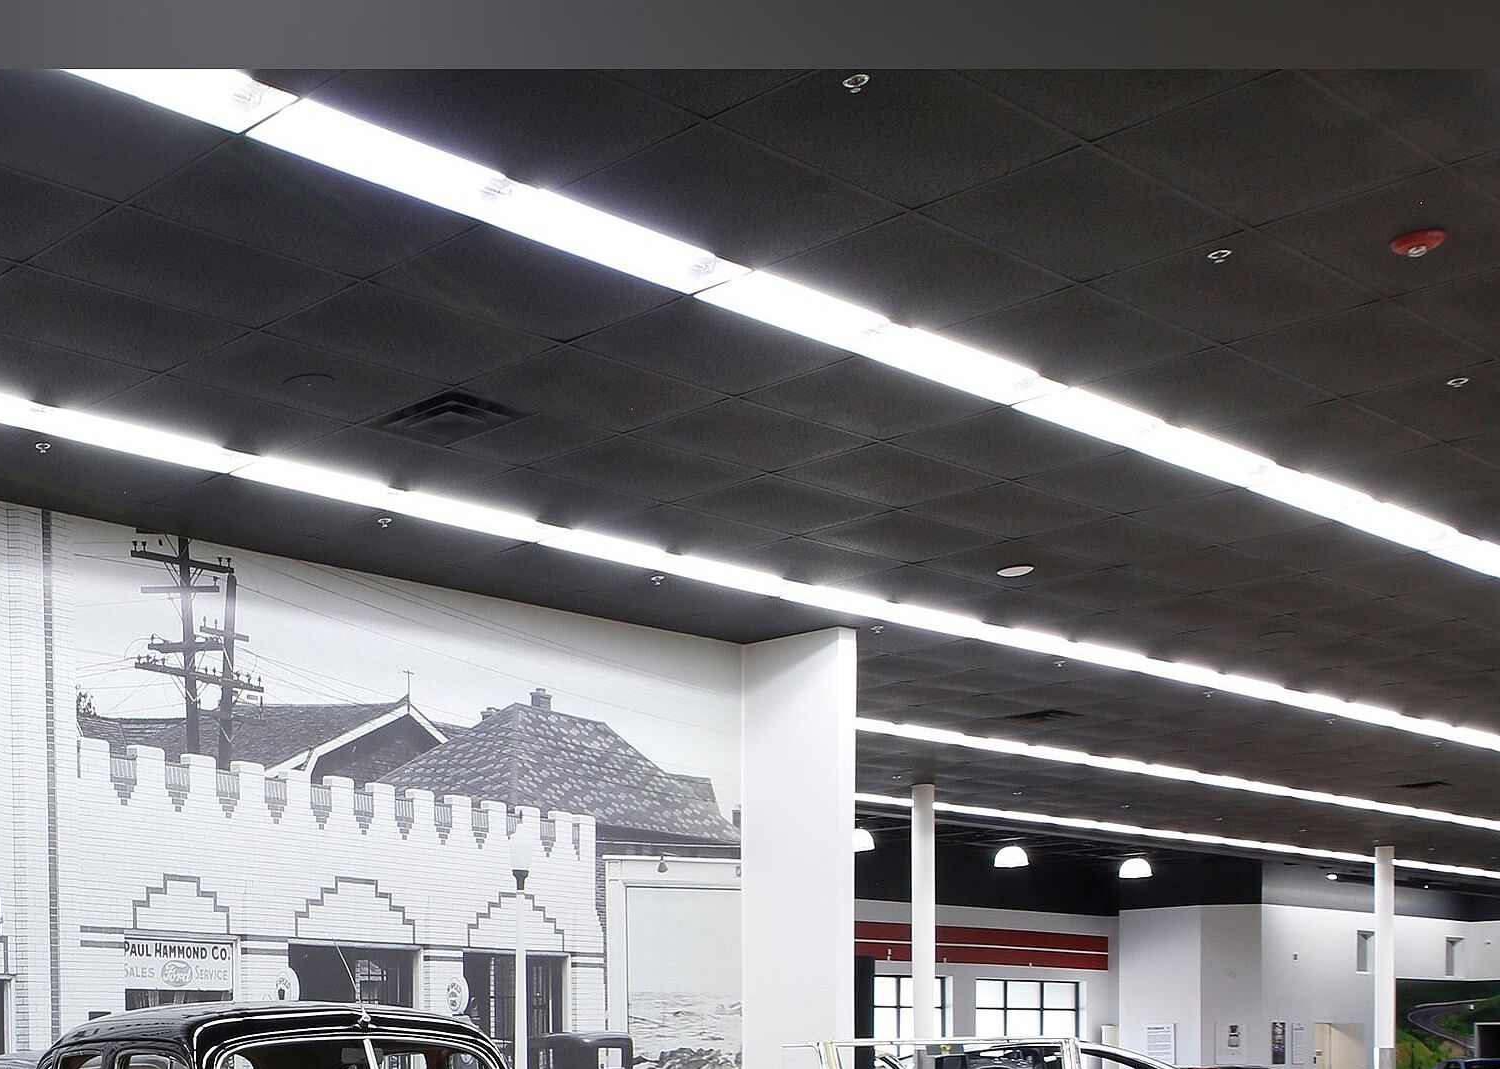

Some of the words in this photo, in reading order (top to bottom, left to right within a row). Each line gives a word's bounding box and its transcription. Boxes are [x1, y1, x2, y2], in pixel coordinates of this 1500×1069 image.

[124, 941, 152, 957] PAUL
[155, 943, 208, 960] HAMMOND
[211, 945, 231, 961] CO.
[124, 963, 155, 979] SALES
[163, 960, 192, 983] Ford
[195, 965, 228, 981] SERVICE
